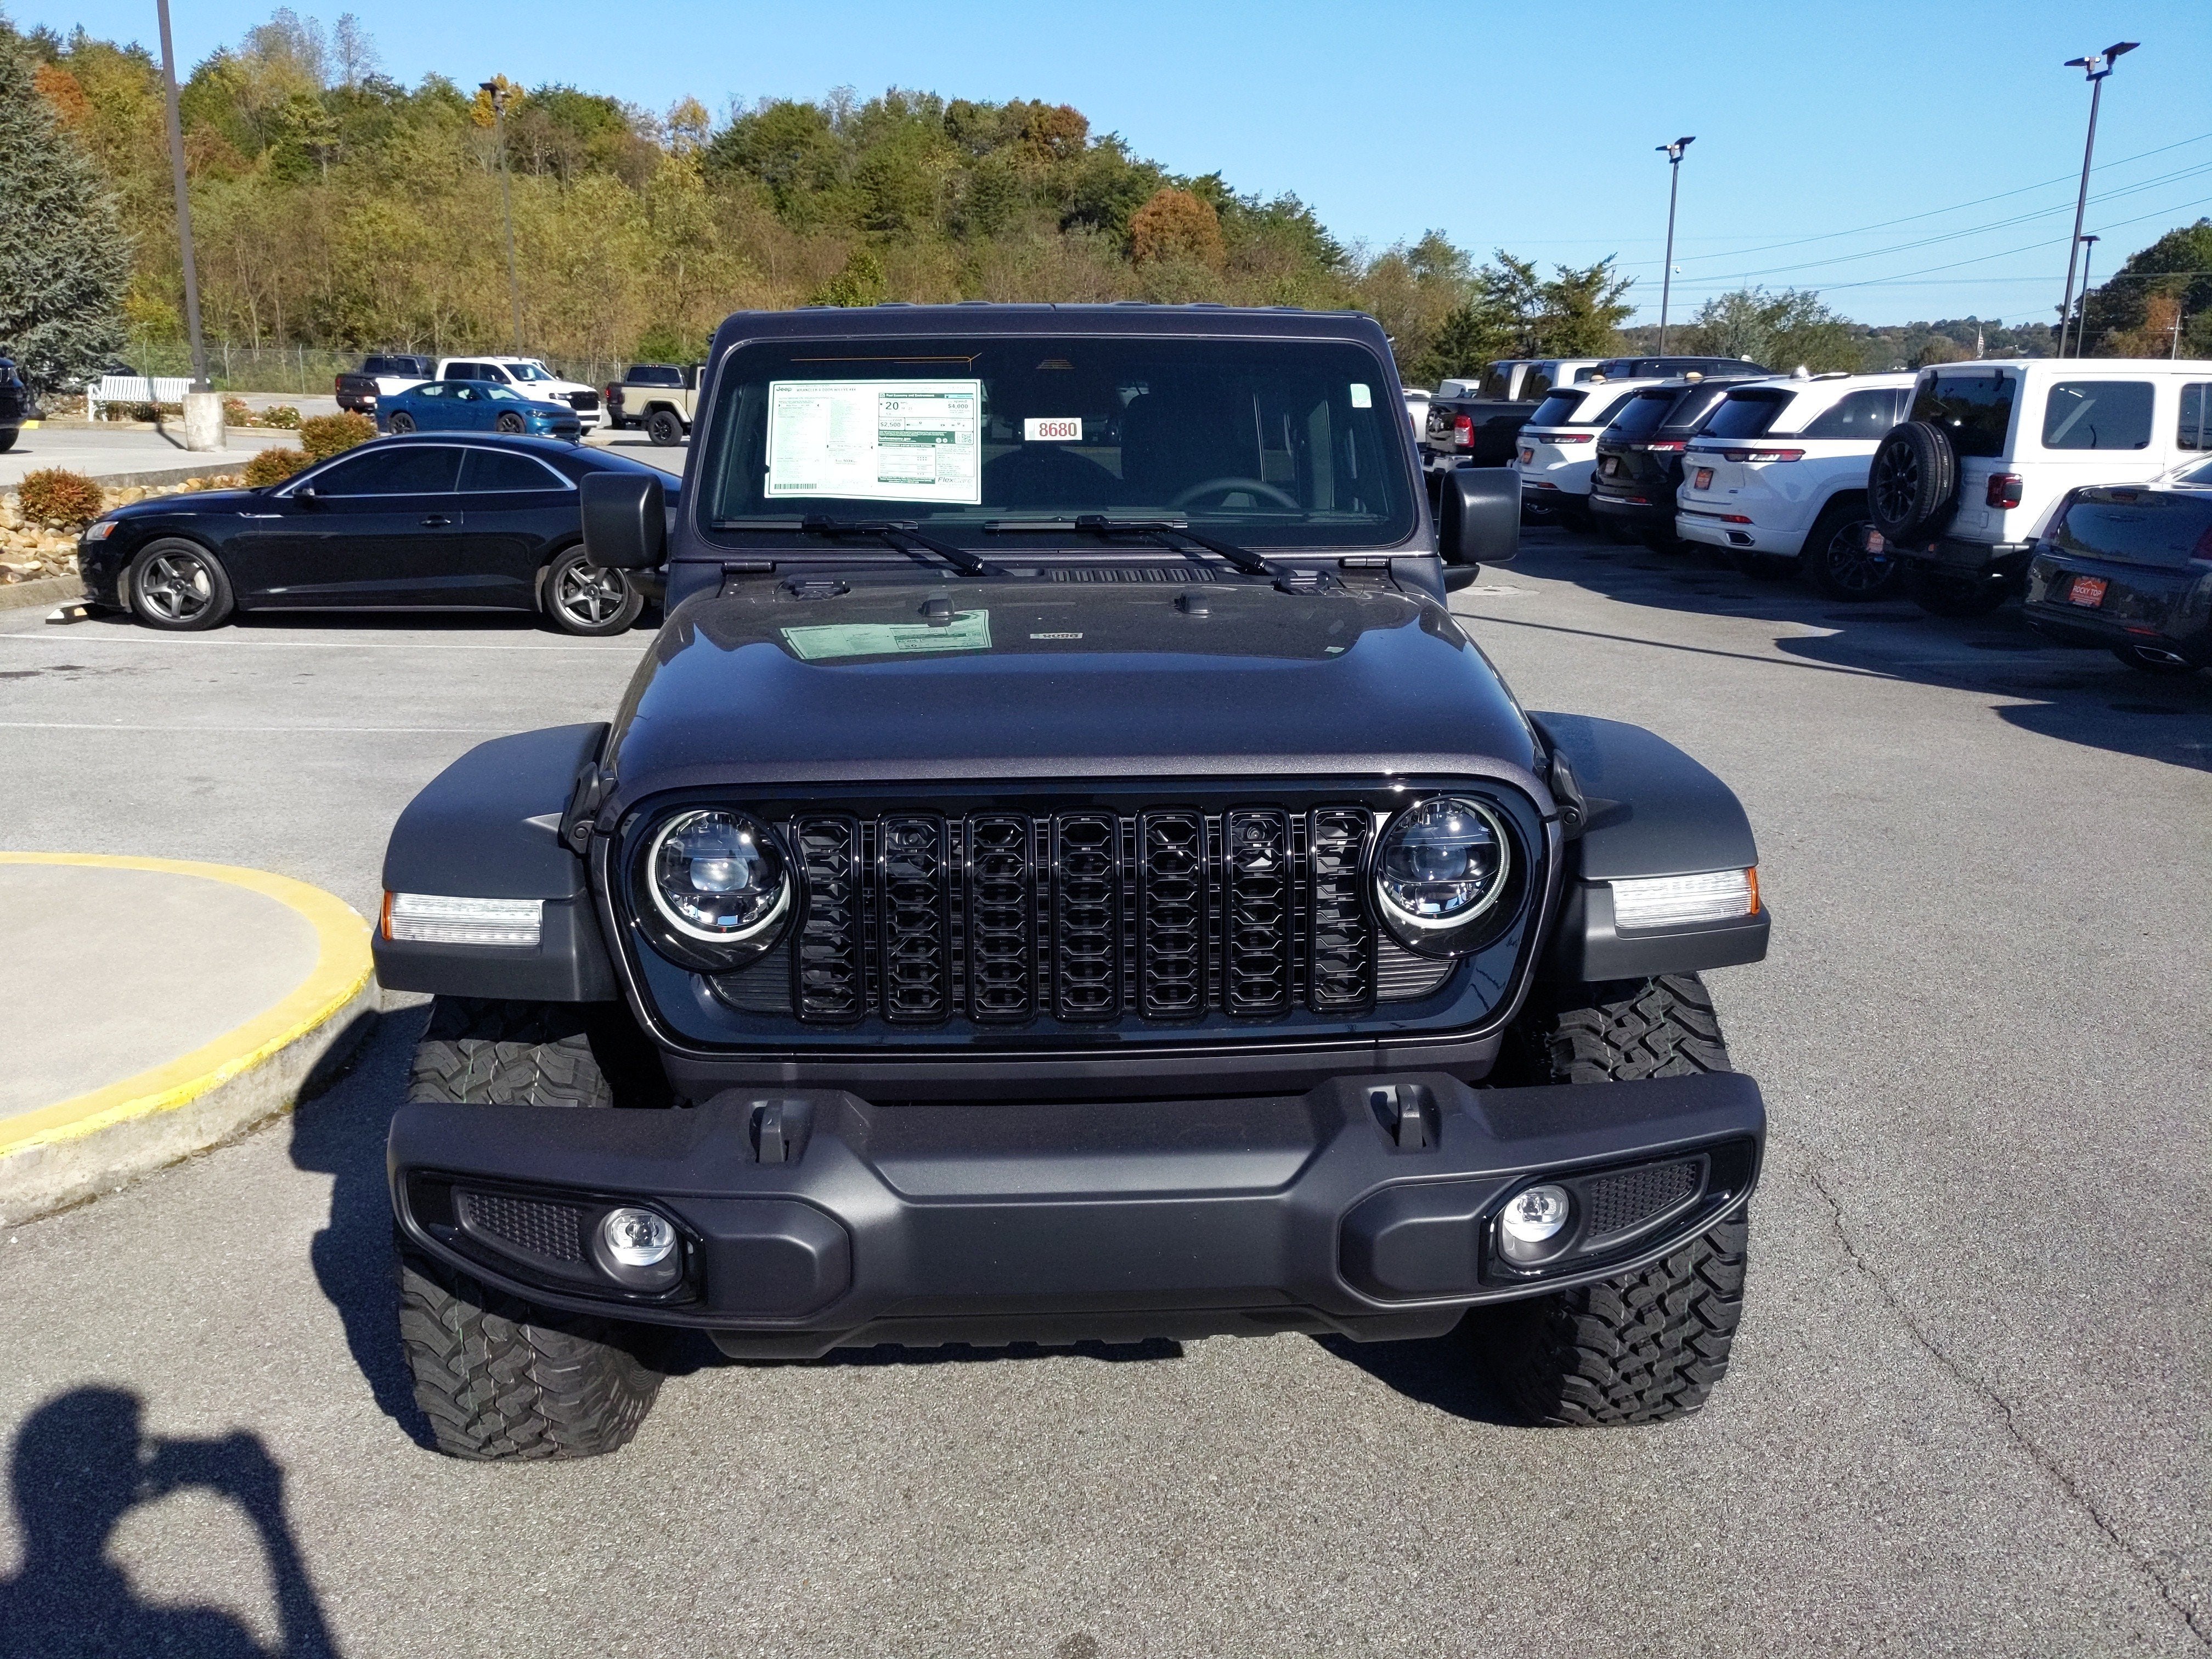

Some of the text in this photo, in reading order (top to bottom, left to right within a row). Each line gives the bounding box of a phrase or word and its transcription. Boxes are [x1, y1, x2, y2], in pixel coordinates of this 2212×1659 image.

[885, 402, 899, 410] 20
[1039, 422, 1077, 437] 8680
[2073, 585, 2102, 597] ROCKY TOP
